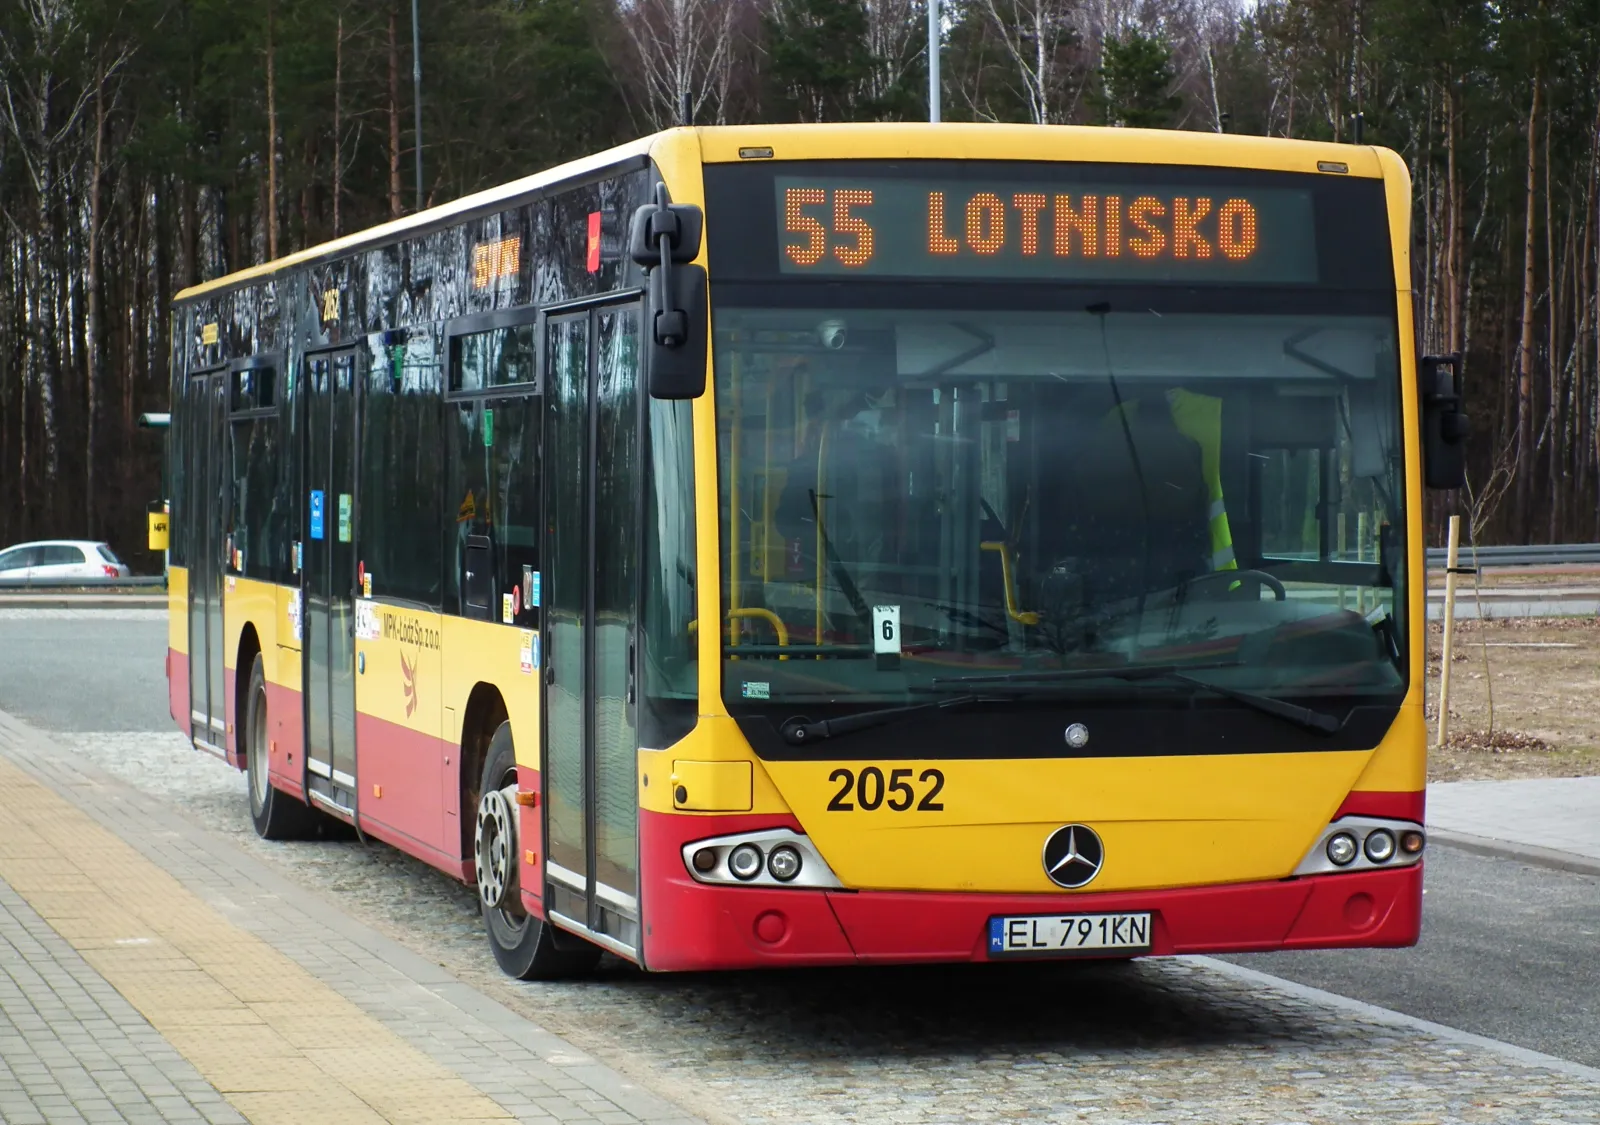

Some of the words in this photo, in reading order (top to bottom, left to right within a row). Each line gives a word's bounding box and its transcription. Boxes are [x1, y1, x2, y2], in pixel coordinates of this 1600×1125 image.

[785, 187, 873, 265] 55
[928, 190, 1257, 260] LOTNISKO
[882, 619, 894, 641] 6
[827, 766, 945, 812] 2052
[992, 937, 1002, 946] PL
[1008, 920, 1048, 948] EL
[1060, 916, 1147, 947] 791KN
